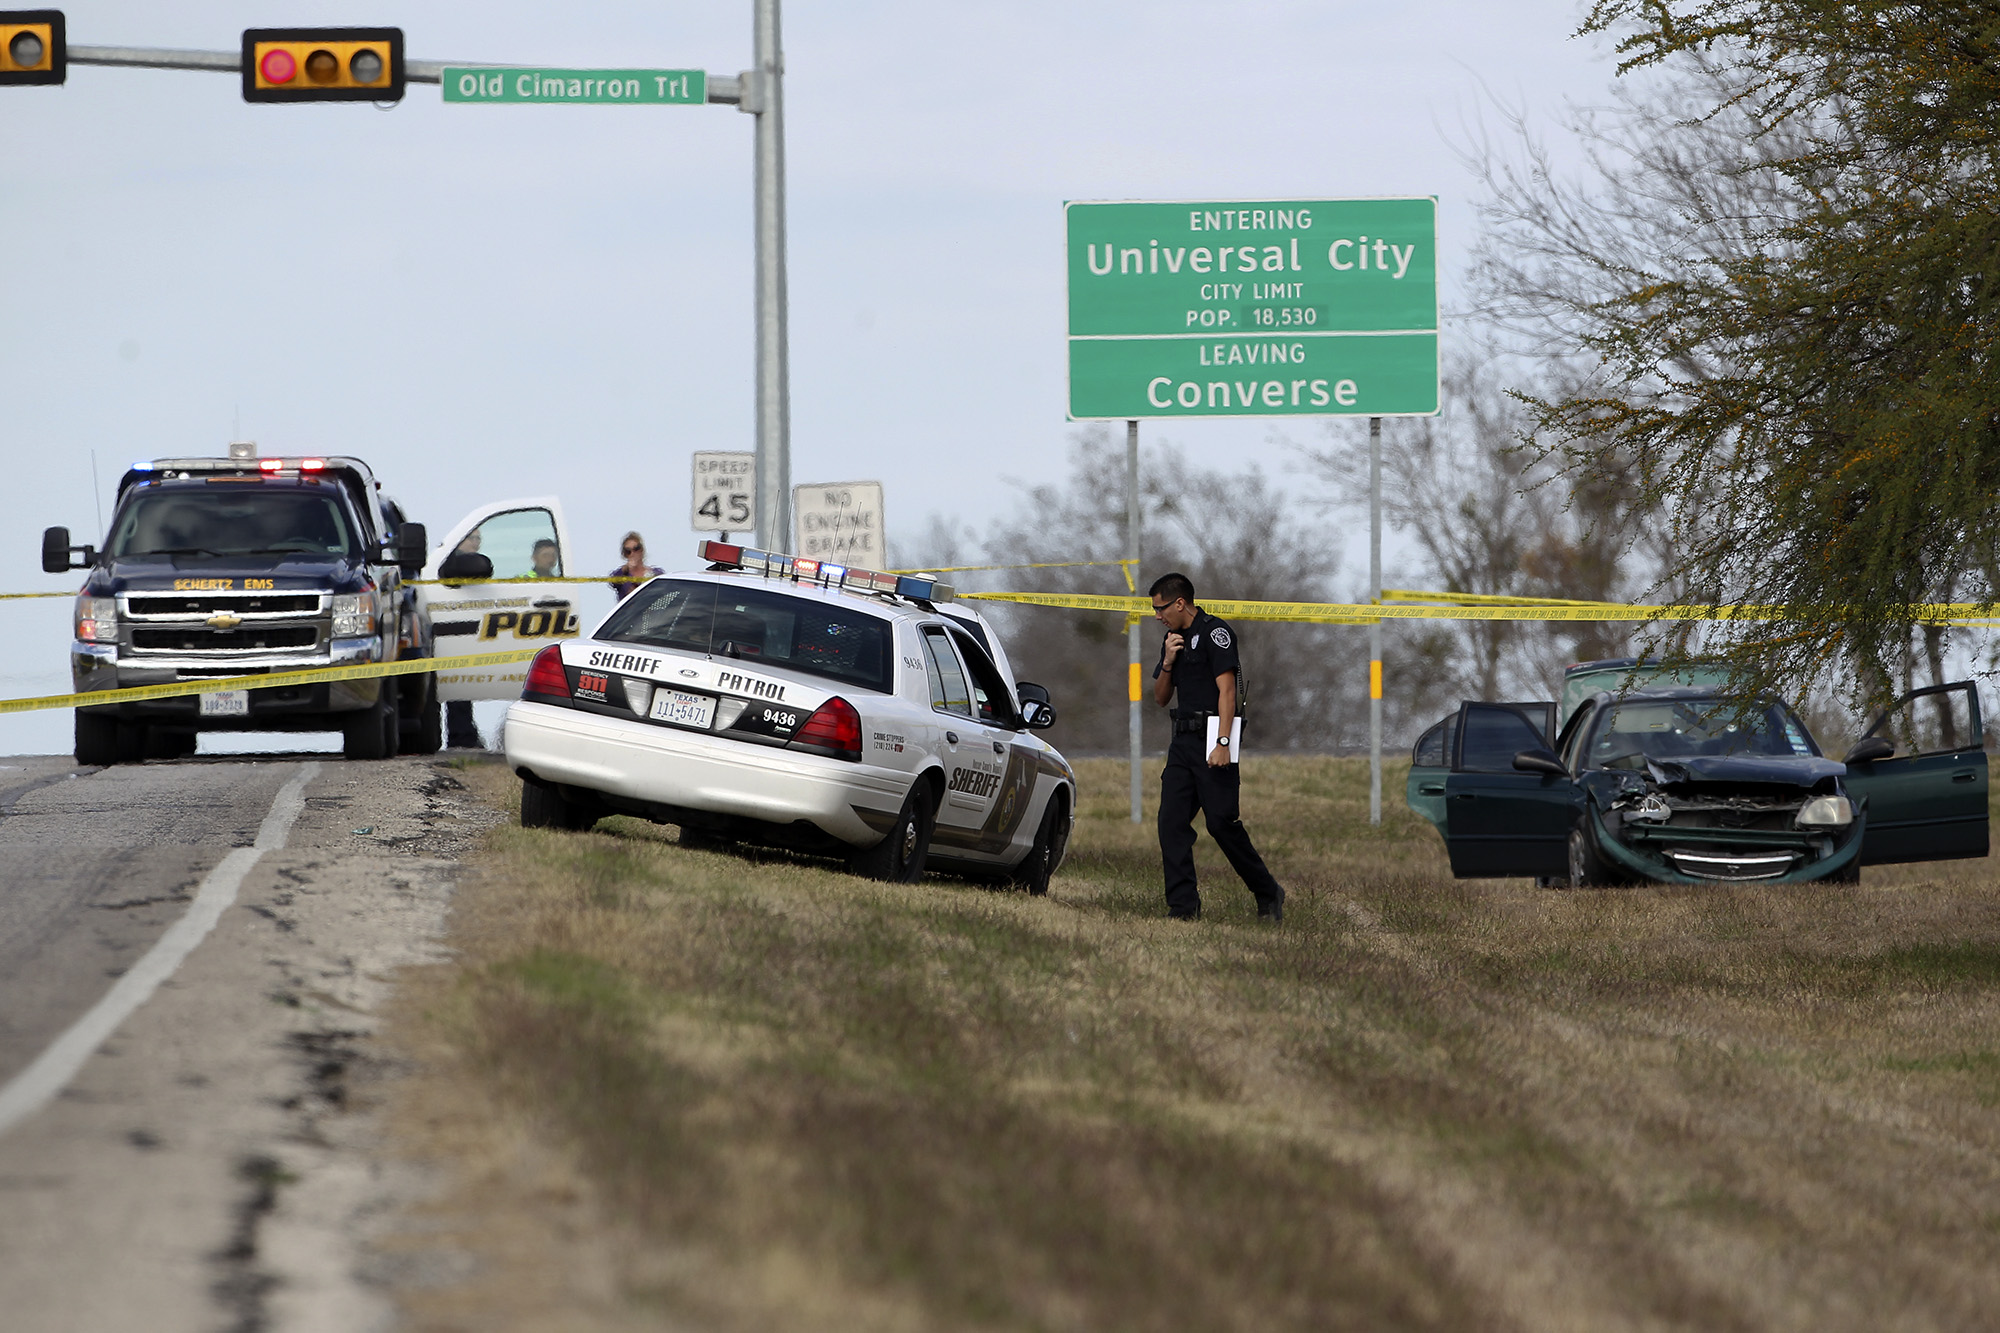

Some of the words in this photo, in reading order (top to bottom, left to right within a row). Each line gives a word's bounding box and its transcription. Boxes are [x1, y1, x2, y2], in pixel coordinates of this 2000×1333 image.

[459, 74, 503, 97] Old
[516, 73, 640, 98] Cimarron
[654, 75, 689, 98] Trl
[1190, 210, 1312, 231] ENTERING
[1087, 238, 1302, 275] Universal
[1328, 236, 1415, 279] City
[1201, 284, 1243, 300] CITY
[1253, 283, 1304, 299] LIMIT
[1186, 310, 1238, 327] POP.
[1253, 308, 1317, 328] 18,530
[1200, 343, 1306, 366] LEAVING
[1147, 377, 1359, 408] Converse
[698, 461, 748, 474] SPEED
[702, 478, 743, 490] LIMIT
[825, 490, 852, 506] NO
[698, 493, 750, 524] 45
[174, 578, 234, 590] SCHERTZ
[244, 578, 274, 590] EMS
[904, 657, 923, 670] 9436
[437, 674, 494, 684] ROTECT
[578, 675, 608, 692] 911
[589, 651, 662, 674] SHERIFF
[717, 672, 786, 702] PATROL
[674, 693, 698, 703] TEXAS
[763, 709, 796, 726] 9436
[948, 767, 1001, 798] SHERIFF
